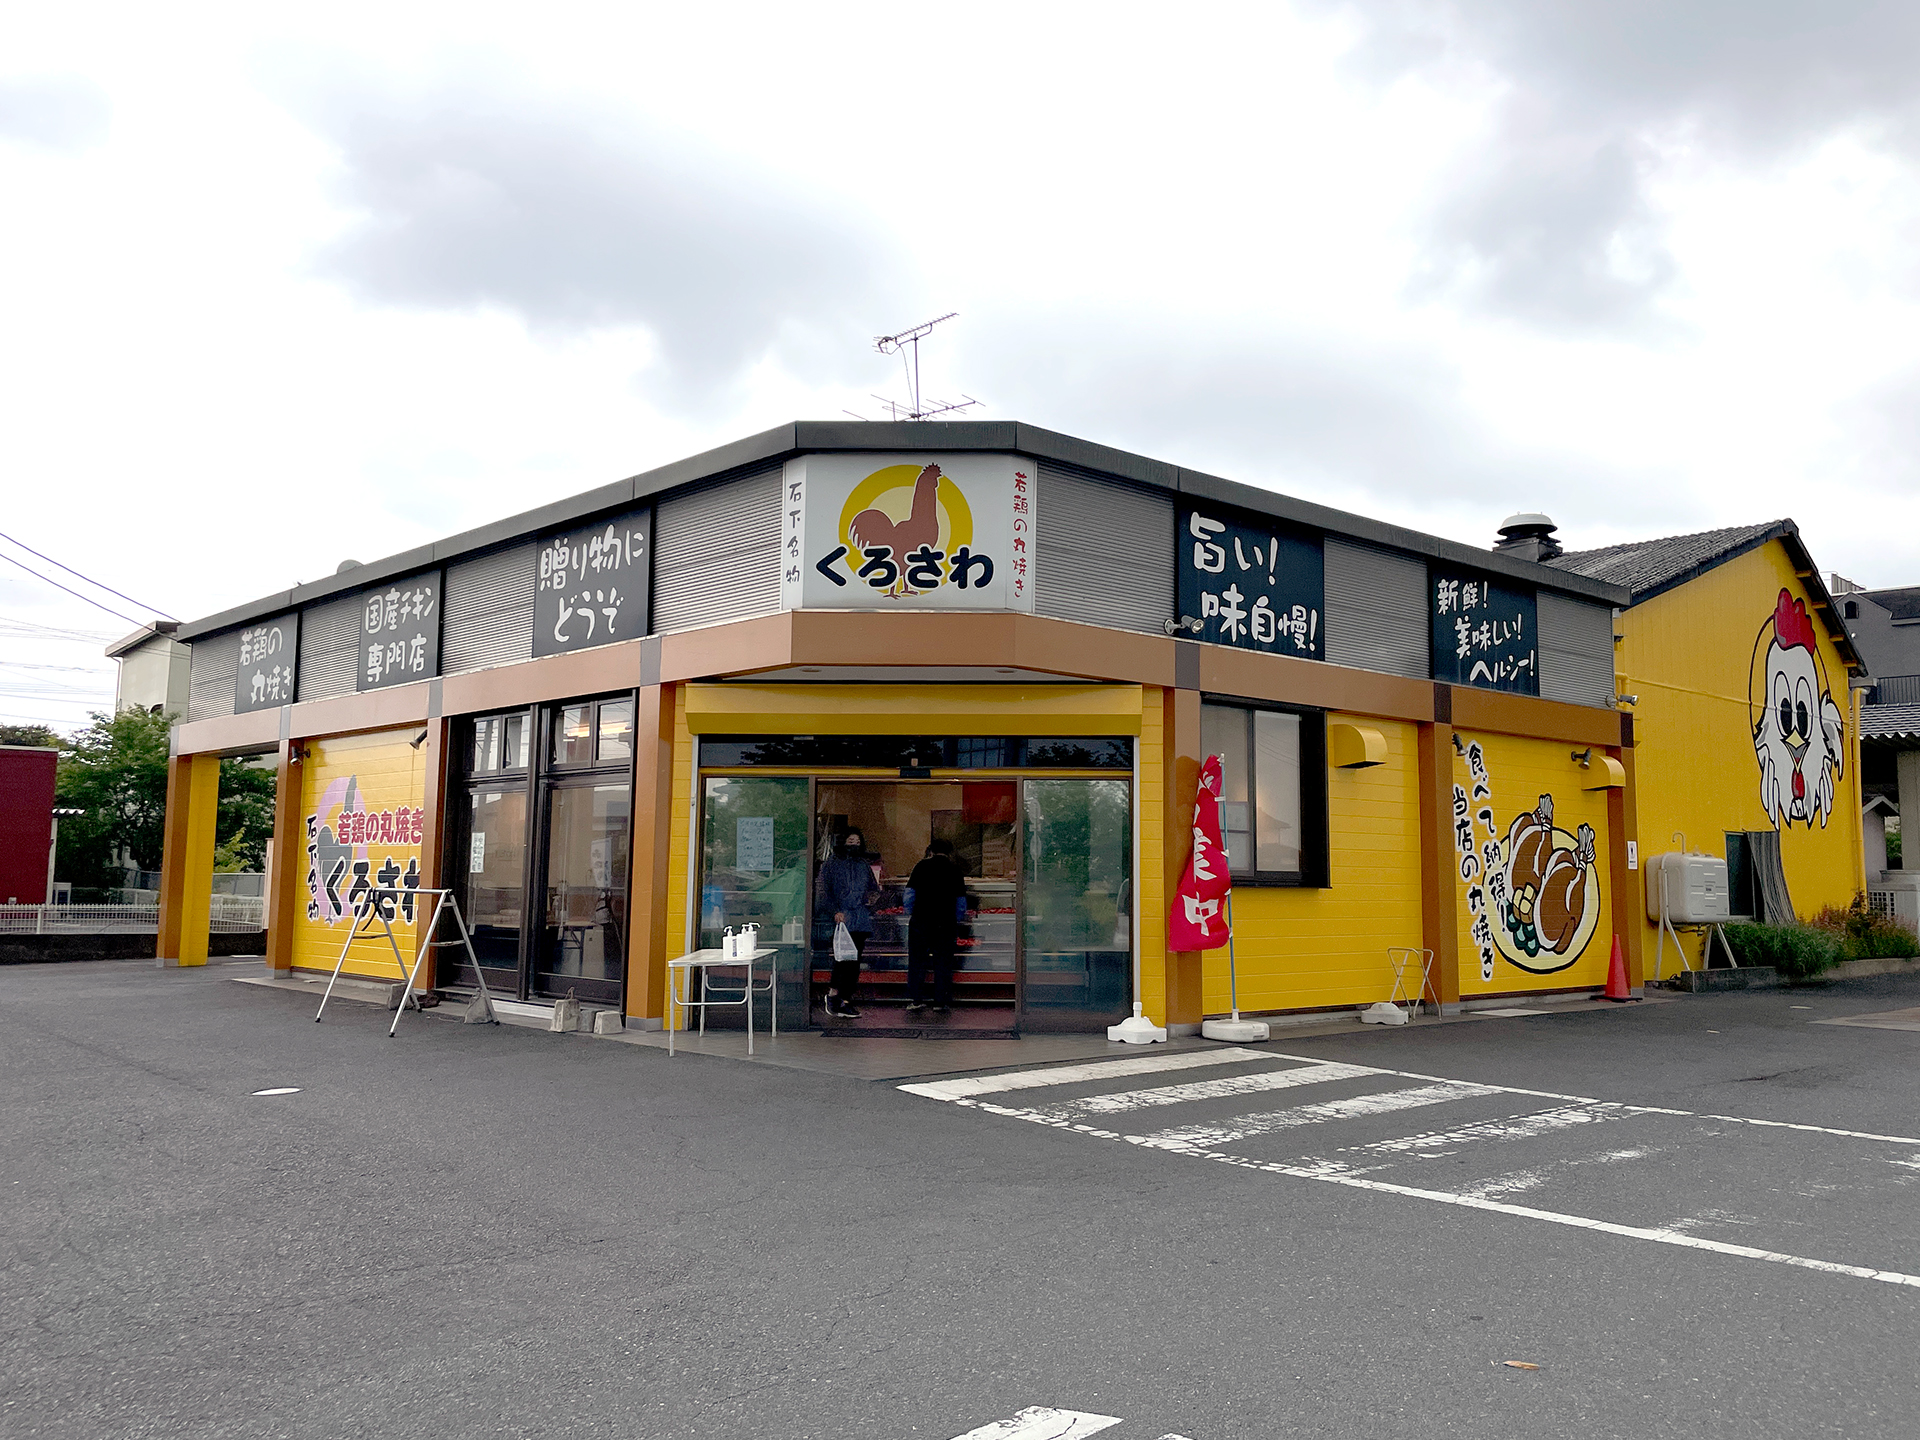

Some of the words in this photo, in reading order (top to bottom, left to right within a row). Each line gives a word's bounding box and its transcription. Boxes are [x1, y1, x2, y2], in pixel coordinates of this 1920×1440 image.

[540, 524, 644, 591] 贈り物に
[786, 482, 802, 583] 石下名物
[1013, 471, 1028, 598] 若鶏の丸焼き
[1190, 511, 1279, 586] 旨い!
[816, 546, 994, 589] くろさわ
[365, 587, 434, 634] 国産チキン
[554, 587, 624, 642] どうぞ
[1201, 583, 1318, 651] 味自慢!
[1438, 579, 1488, 615] 新鮮!
[240, 627, 283, 666] 若鶏の
[367, 633, 427, 683] 専門店
[251, 664, 292, 704] 丸焼き
[338, 806, 424, 845] 若鶏の丸焼き
[307, 815, 320, 920] 石下名物
